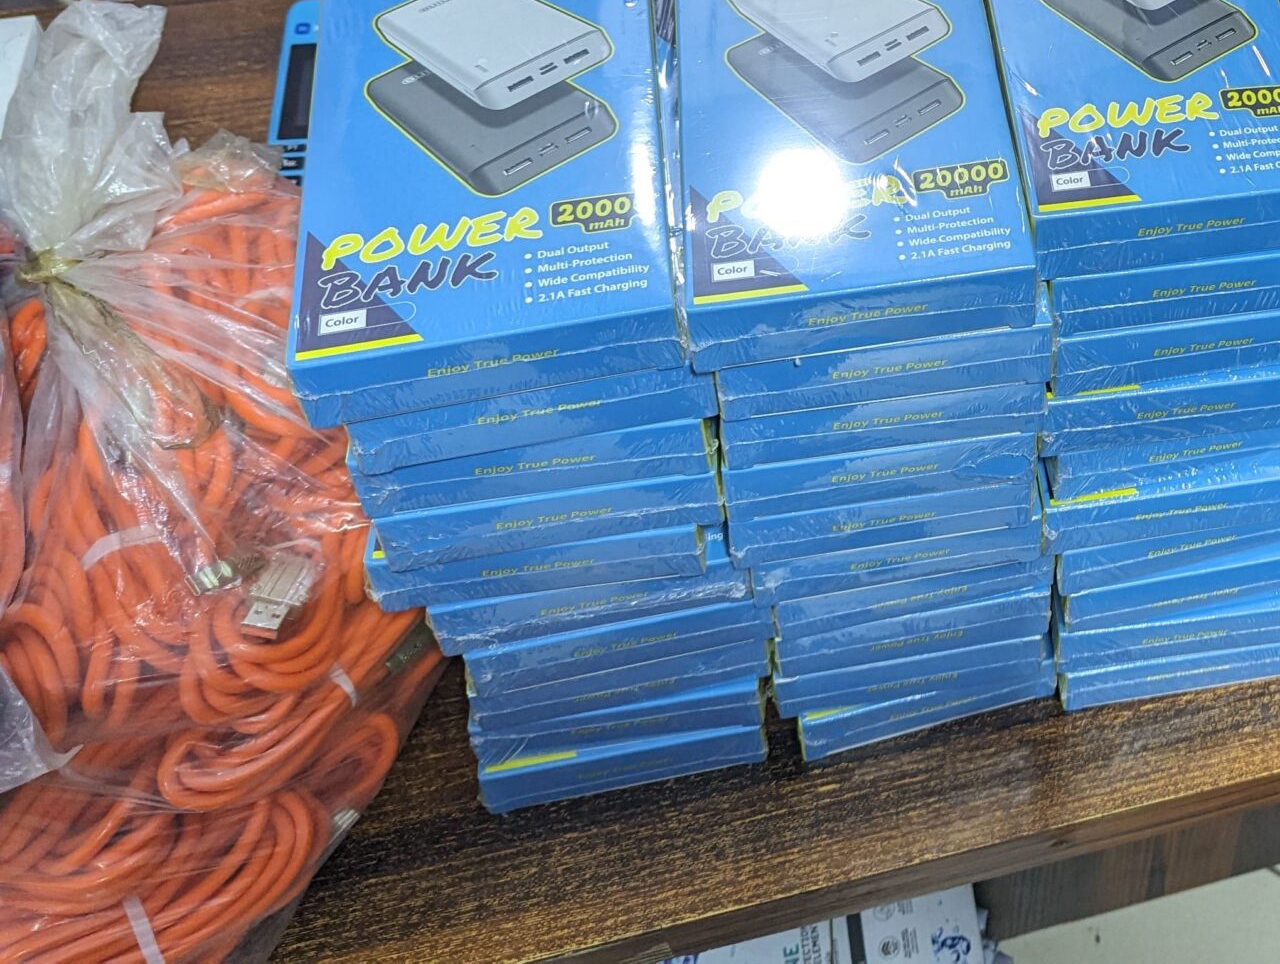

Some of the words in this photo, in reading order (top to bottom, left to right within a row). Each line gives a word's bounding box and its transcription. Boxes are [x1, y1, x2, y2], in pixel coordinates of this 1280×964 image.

[1037, 92, 1219, 138] POWER
[1219, 127, 1241, 137] Dual
[1244, 123, 1278, 135] Output
[1040, 128, 1190, 170] BANK
[1226, 150, 1250, 161] Wide
[919, 161, 1004, 189] 20000
[1230, 164, 1252, 174] 2.1A
[1254, 160, 1274, 171] Fast
[950, 185, 982, 197] mAh
[1056, 175, 1084, 186] Color
[557, 197, 640, 223] 2000
[905, 211, 931, 222] Dual
[933, 206, 970, 220] Output
[589, 218, 624, 230] mAh
[907, 216, 994, 234] Multi-Protection
[1138, 227, 1174, 237] Enjoy
[1176, 223, 1203, 231] True
[1204, 217, 1246, 228] Power
[321, 206, 543, 271] POWER
[908, 236, 936, 247] Wide
[938, 226, 1011, 246] Compatibility
[537, 247, 564, 259] Dual
[567, 241, 609, 257] Output
[911, 250, 935, 260] 2.1A
[937, 246, 961, 256] Fast
[962, 239, 1011, 255] Charging
[538, 252, 632, 273] Multi-Protection
[717, 264, 748, 276] Color
[318, 252, 498, 309] BANK
[538, 276, 568, 288] Wide
[570, 264, 650, 285] Compatibility
[538, 290, 564, 303] 2.1A
[566, 286, 592, 298] Fast
[594, 278, 648, 296] Charging
[325, 314, 359, 328] Color
[808, 316, 847, 326] Enjoy
[850, 310, 882, 320] True
[884, 305, 928, 316] Power
[427, 364, 470, 378] Enjoy
[473, 358, 508, 369] True
[512, 349, 559, 363] Power
